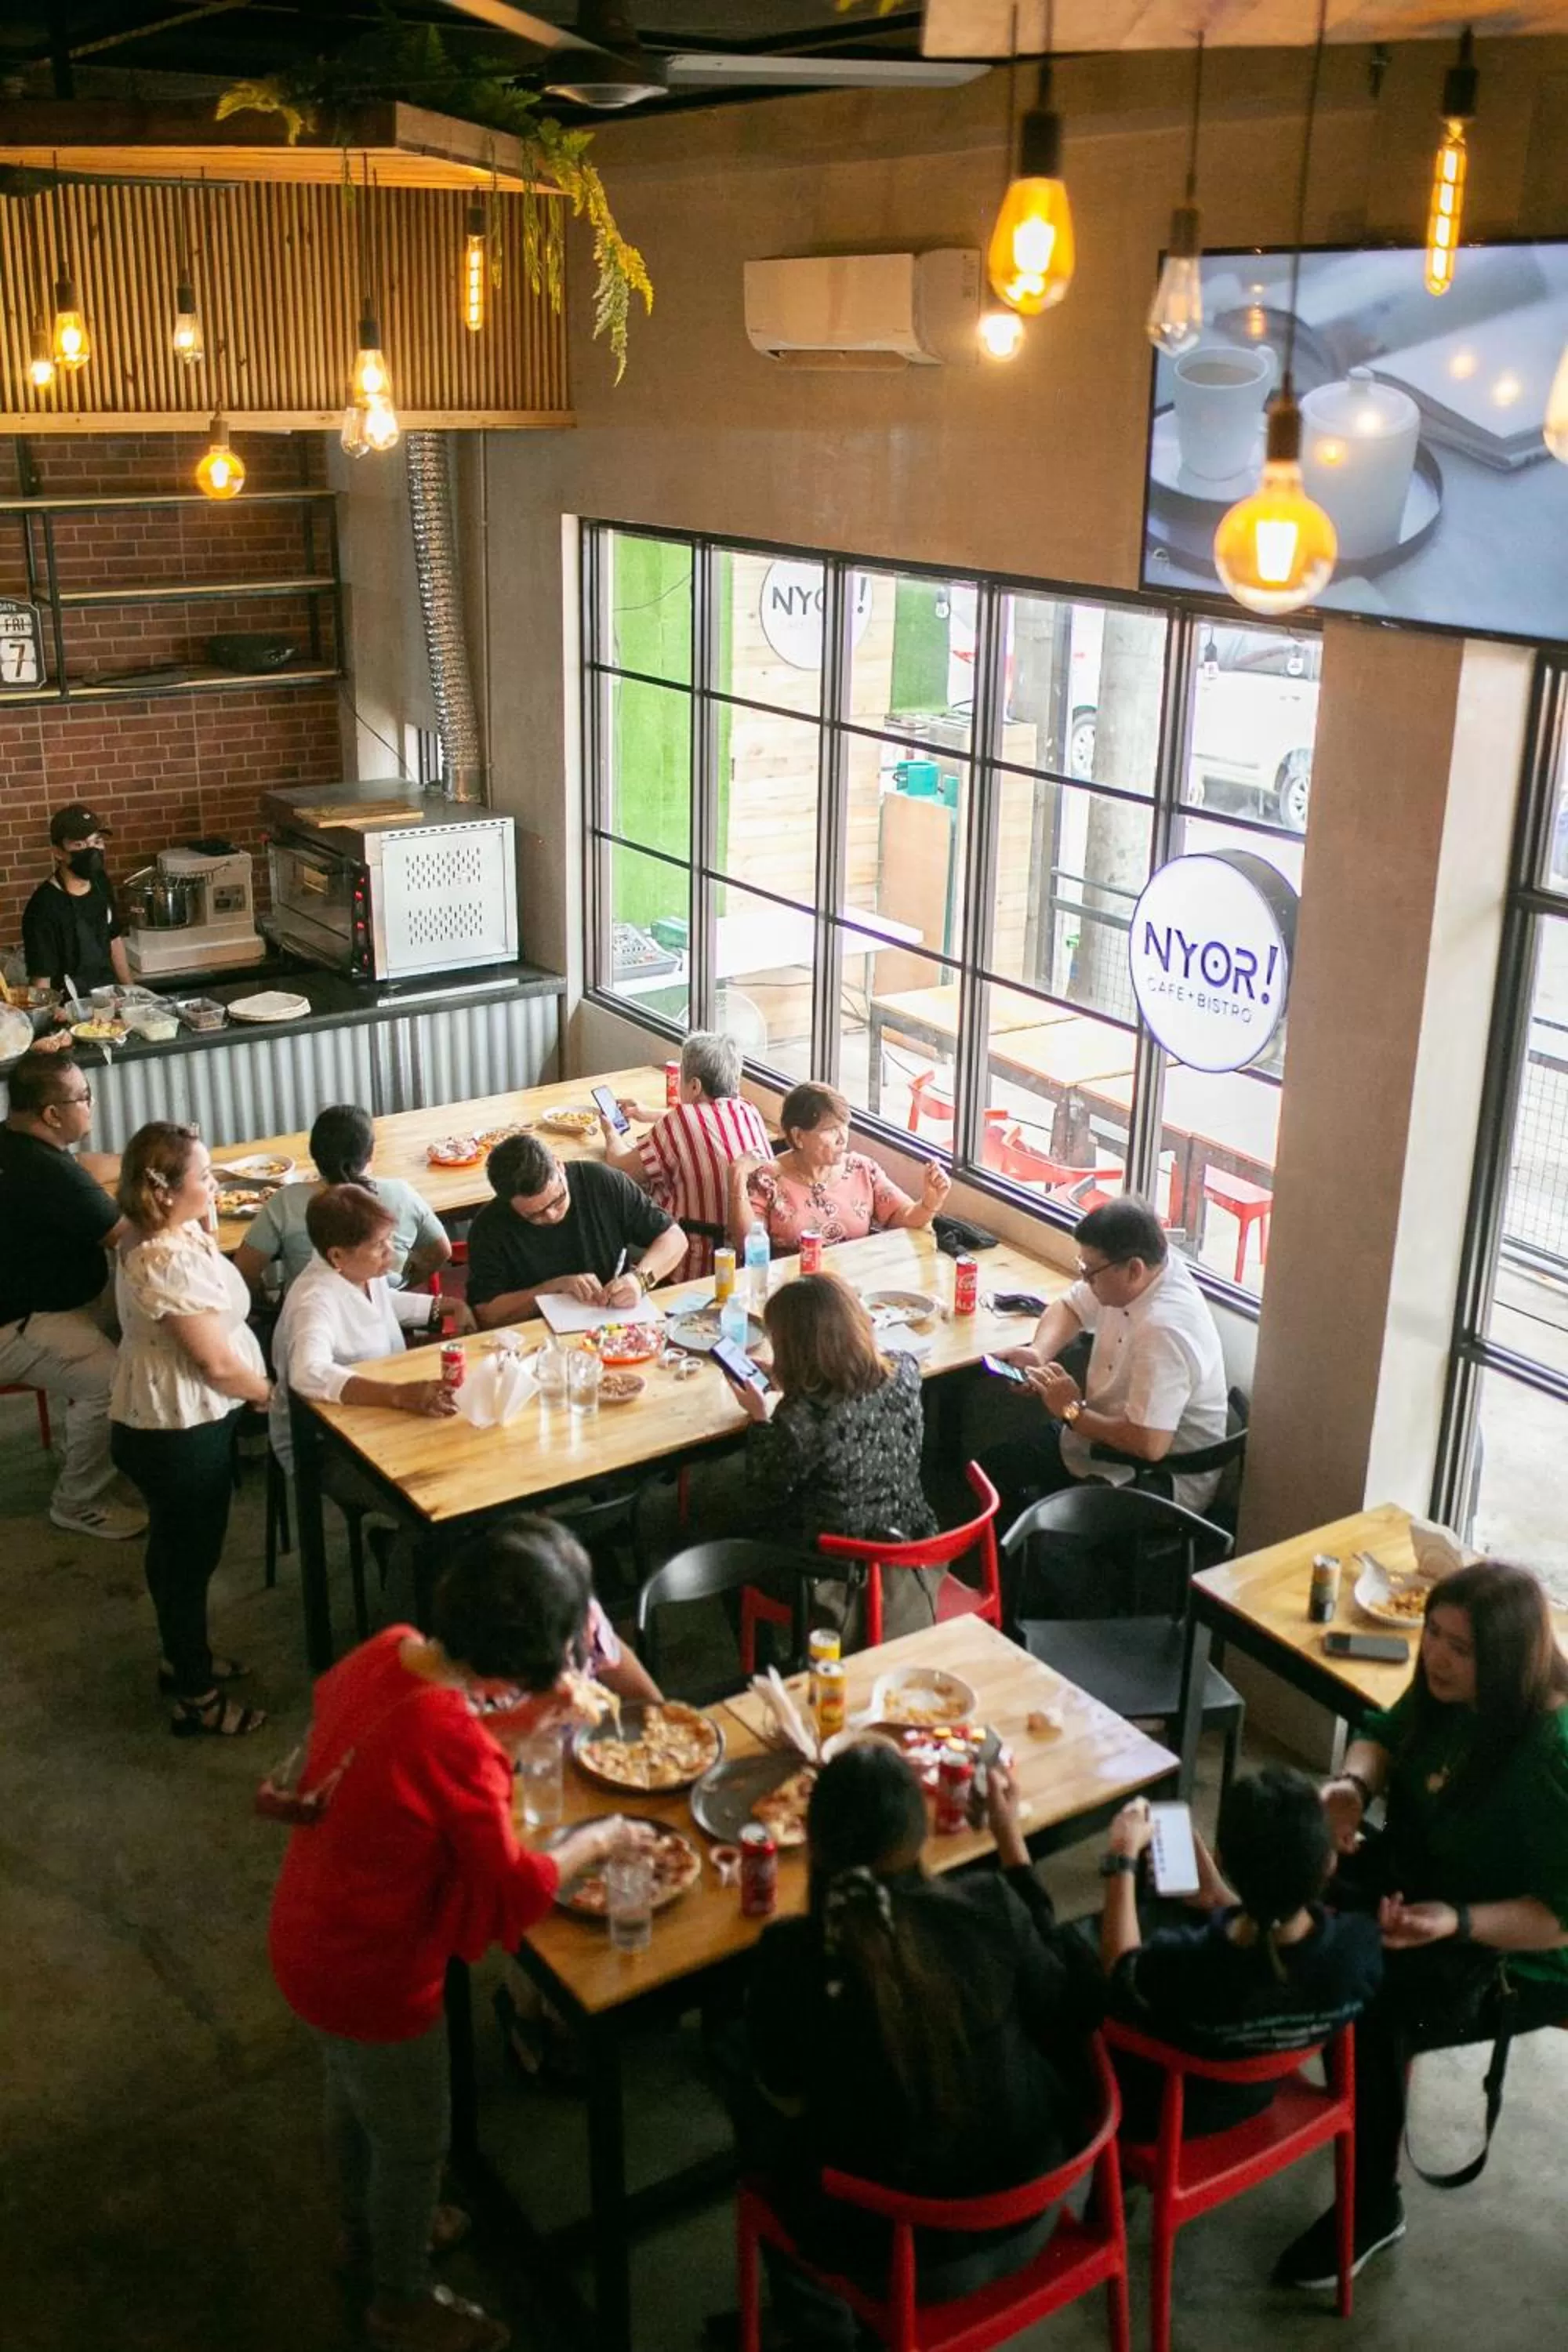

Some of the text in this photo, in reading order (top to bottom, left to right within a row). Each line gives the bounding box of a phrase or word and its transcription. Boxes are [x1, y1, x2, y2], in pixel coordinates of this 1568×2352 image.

[5, 617, 25, 632] FRI
[9, 643, 25, 677] 7
[1144, 921, 1279, 1005] NYOR!
